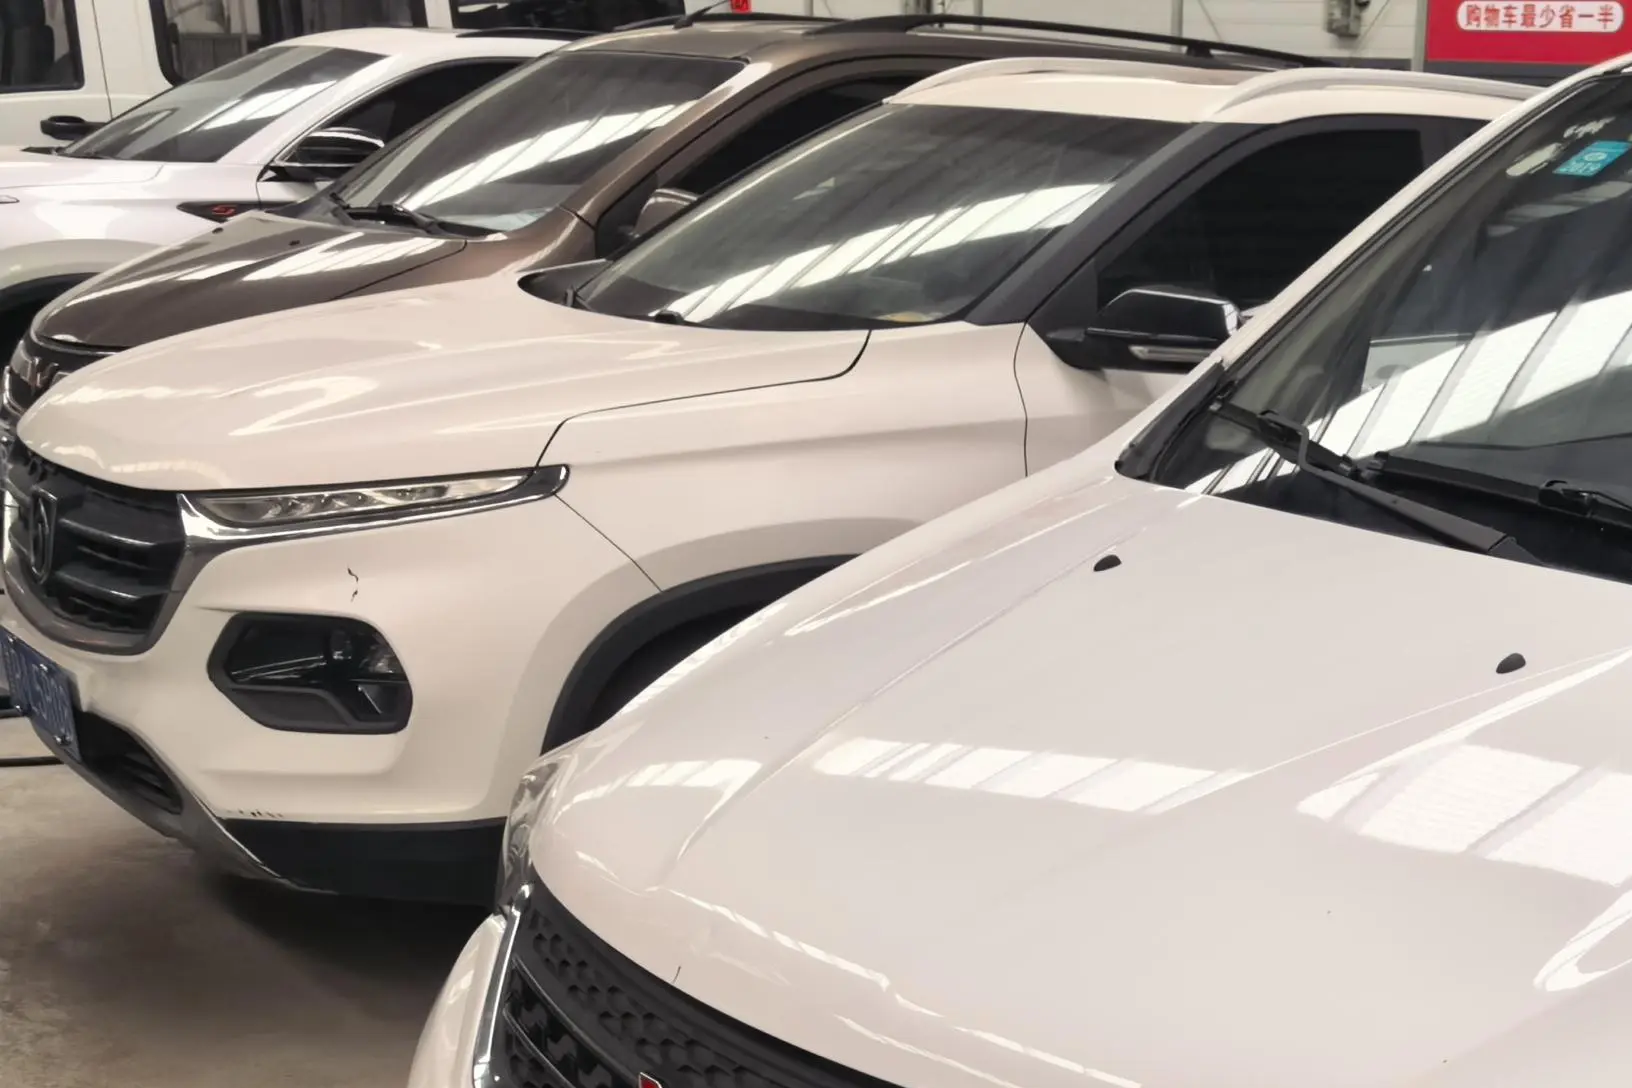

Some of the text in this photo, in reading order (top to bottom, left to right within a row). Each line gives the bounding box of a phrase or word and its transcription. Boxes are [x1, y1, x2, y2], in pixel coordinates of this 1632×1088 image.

[1464, 4, 1615, 30] 购物车最少省一半
